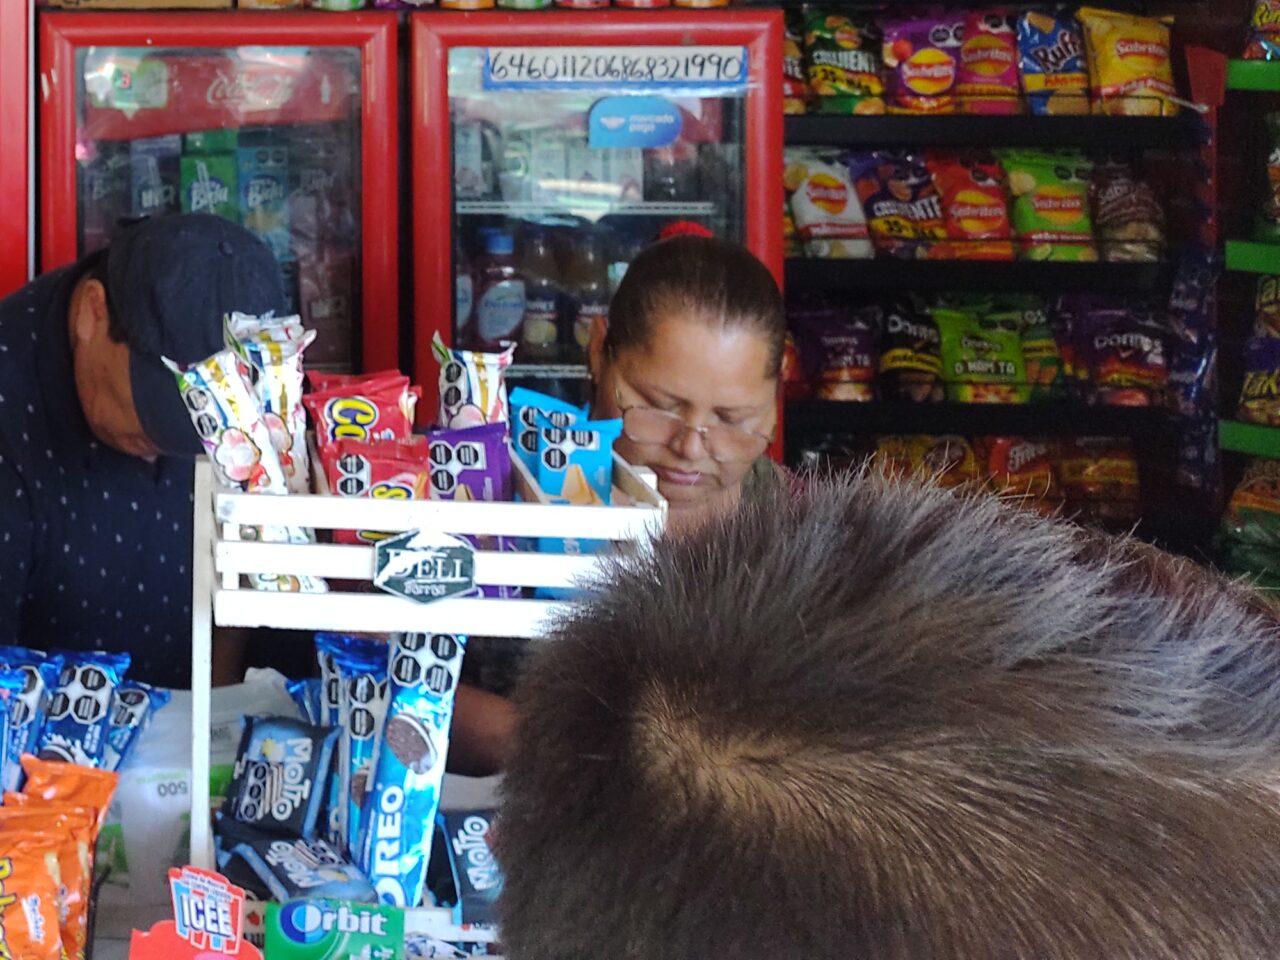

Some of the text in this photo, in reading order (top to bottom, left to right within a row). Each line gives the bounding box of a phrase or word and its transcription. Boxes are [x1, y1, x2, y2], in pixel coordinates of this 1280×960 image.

[629, 123, 656, 134] pago
[630, 114, 674, 124] mercado
[374, 784, 406, 908] OREO
[182, 893, 234, 937] ICEE
[280, 900, 388, 944] Orbit
